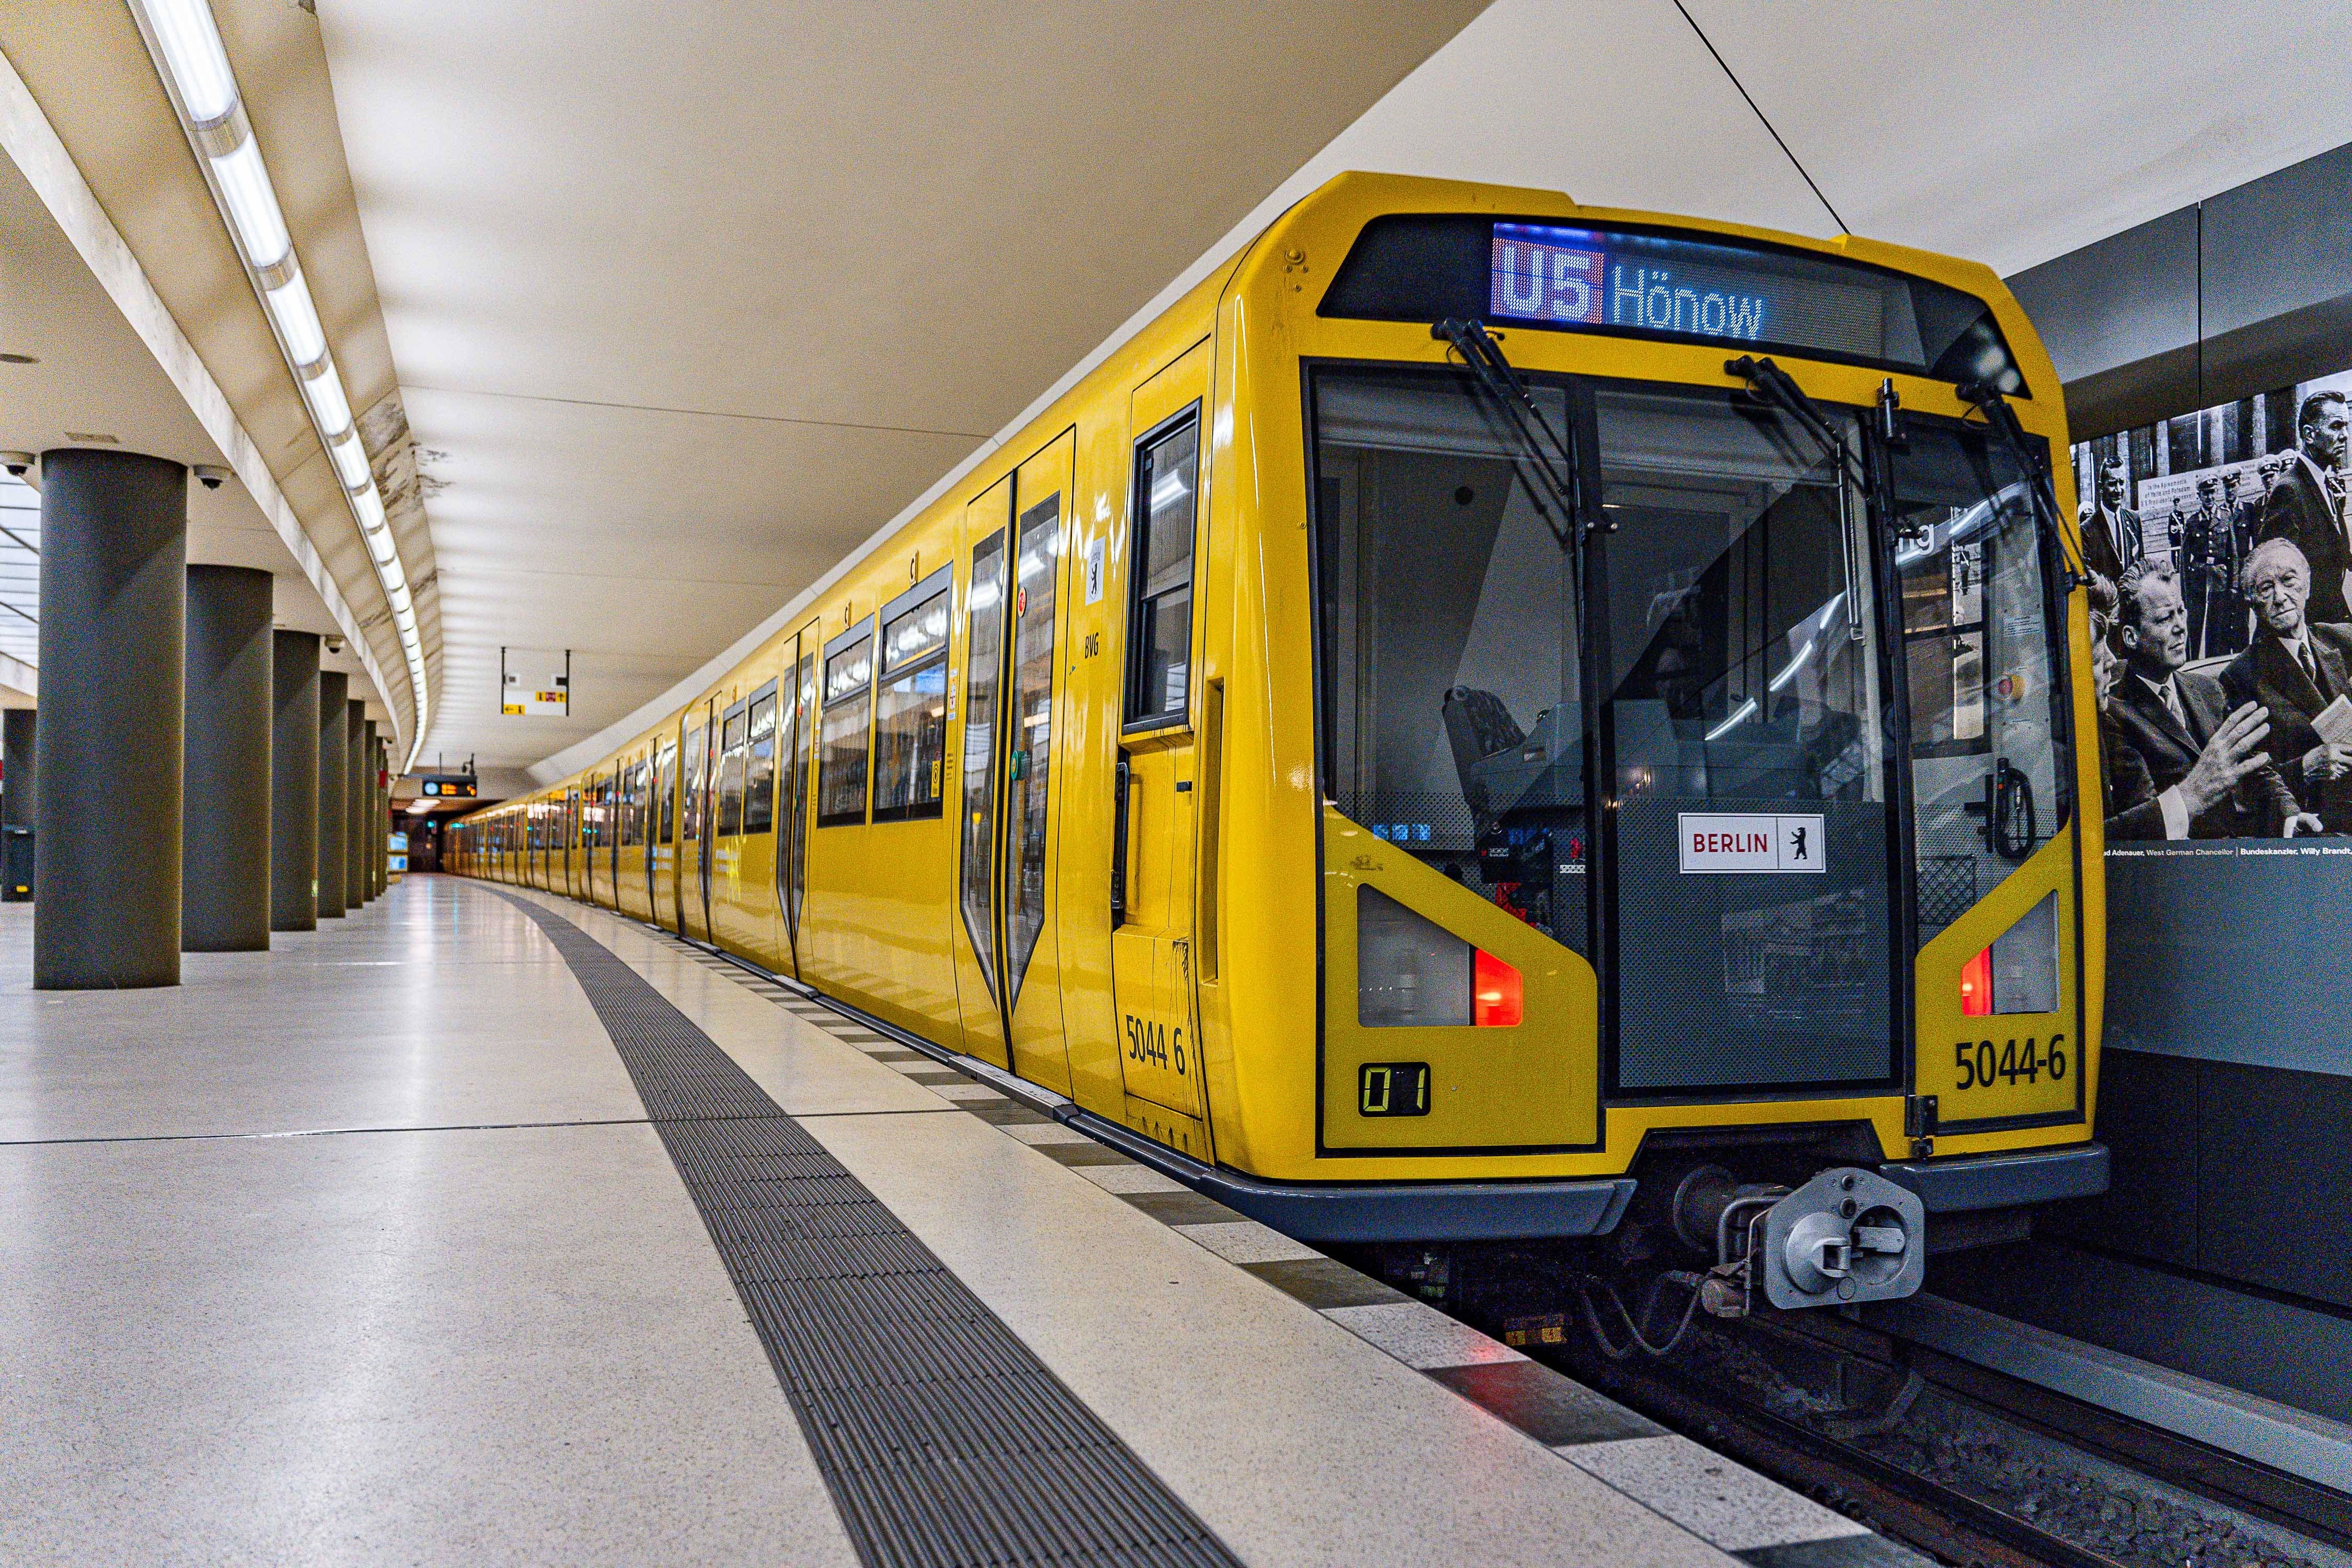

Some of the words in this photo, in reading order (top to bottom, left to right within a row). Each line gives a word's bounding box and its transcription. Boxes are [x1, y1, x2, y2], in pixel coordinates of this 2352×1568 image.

[1501, 244, 1591, 319] U5
[1612, 265, 1762, 340] Hönow
[1085, 632, 1099, 659] BVG
[1693, 833, 1769, 853] BERLIN
[2300, 847, 2321, 856] Willy
[1126, 1014, 1168, 1069] 5044
[1174, 1028, 1185, 1076] 6
[1956, 1034, 2066, 1090] 5044-6
[1364, 1067, 1424, 1112] 01
